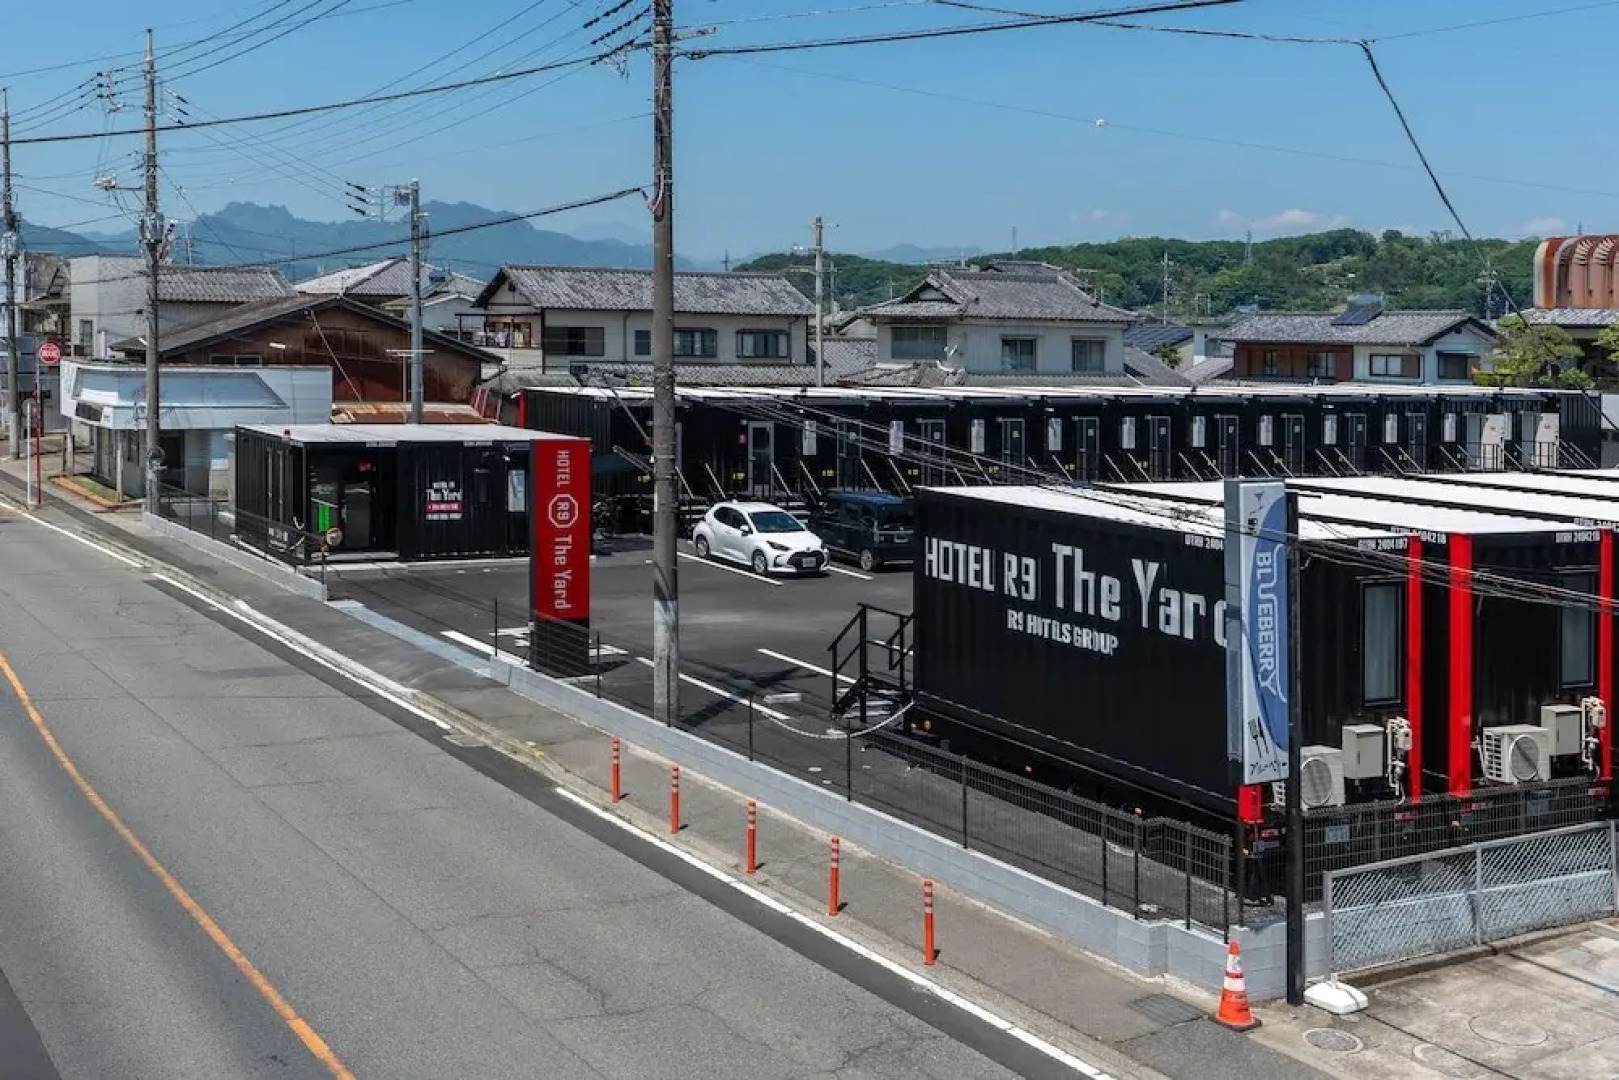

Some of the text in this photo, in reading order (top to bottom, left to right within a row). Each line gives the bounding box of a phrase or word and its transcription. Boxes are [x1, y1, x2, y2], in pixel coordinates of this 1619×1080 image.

[554, 450, 573, 610] HOTEL R9 The Yard
[925, 536, 995, 592] HOTEL
[1004, 552, 1037, 601] R9
[1052, 542, 1121, 622] The
[1073, 624, 1119, 656] GROUP
[1256, 551, 1278, 696] BLUEBERRY
